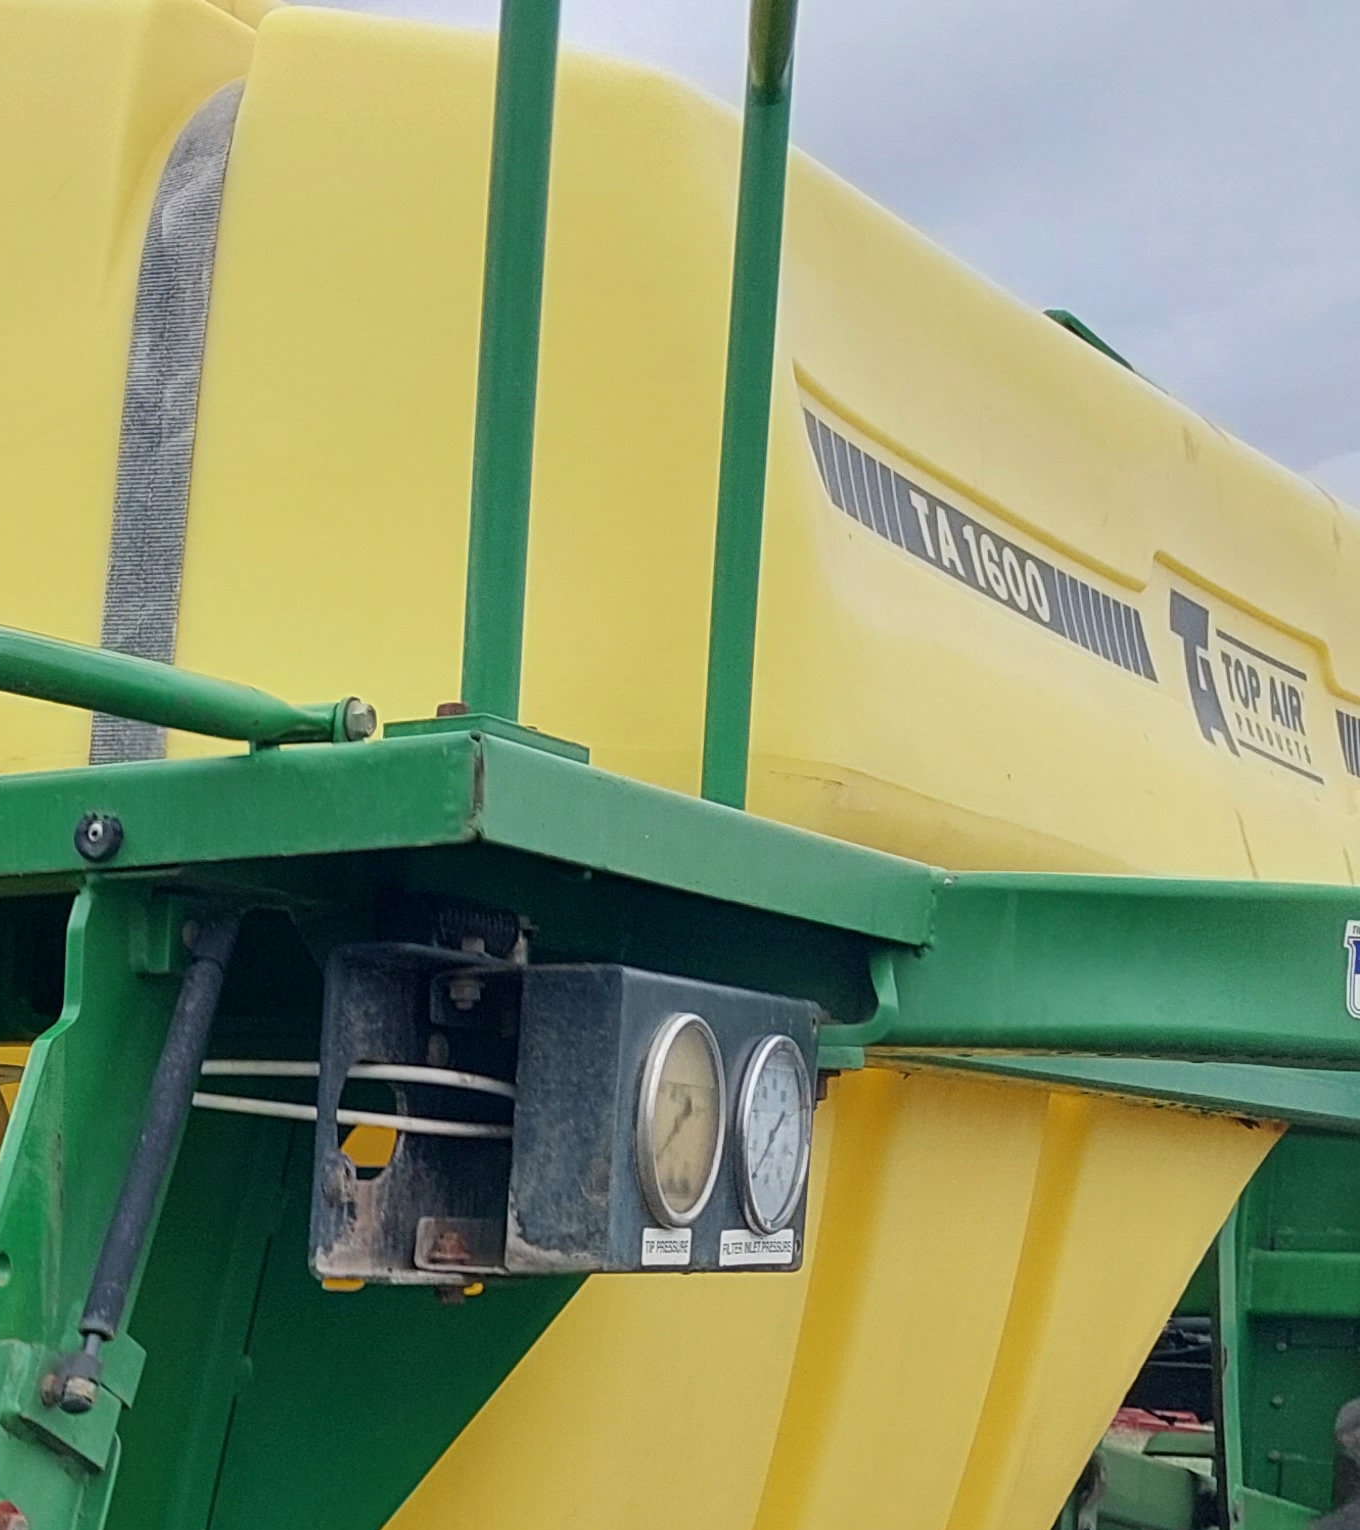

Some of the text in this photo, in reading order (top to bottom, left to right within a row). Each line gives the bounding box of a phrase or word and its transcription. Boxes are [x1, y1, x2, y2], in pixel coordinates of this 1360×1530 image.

[909, 489, 1051, 624] TA 1600
[1220, 650, 1261, 714] TOP
[1235, 711, 1312, 765] PRODUCTS
[656, 1239, 689, 1254] PRESSURE
[762, 1239, 792, 1253] PRESSURE
